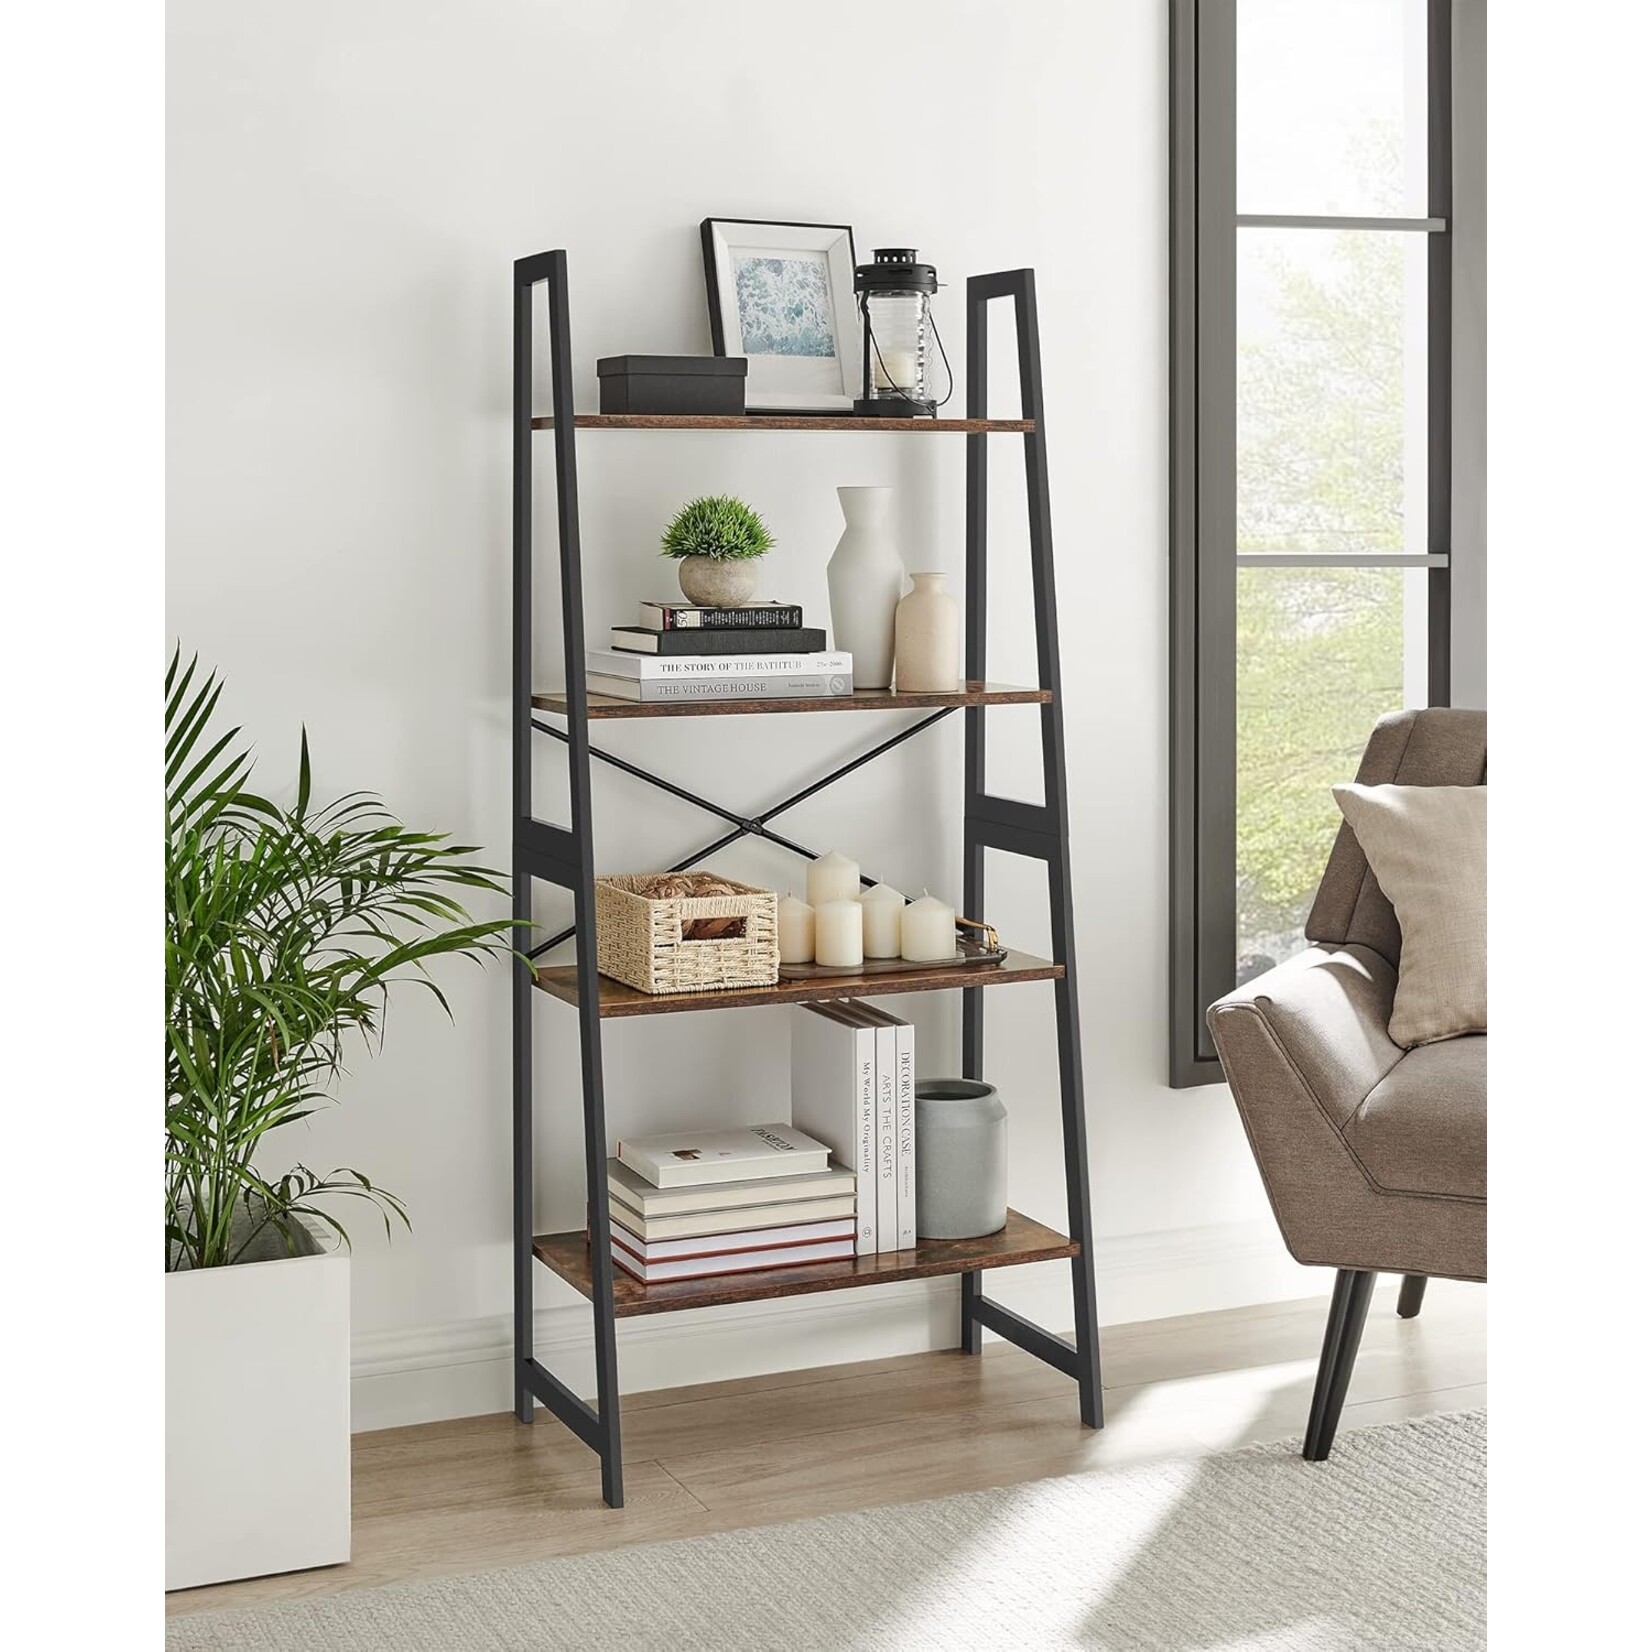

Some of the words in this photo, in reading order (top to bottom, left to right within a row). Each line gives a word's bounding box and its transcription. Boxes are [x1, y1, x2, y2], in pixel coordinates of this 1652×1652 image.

[660, 664, 682, 673] THE
[684, 663, 717, 672] STORY
[718, 662, 732, 671] OF
[734, 662, 755, 671] THE
[756, 661, 802, 671] BATHTUB
[656, 685, 680, 695] THE
[682, 684, 730, 694] VINTAGE
[730, 683, 767, 693] HOUSE
[862, 1062, 871, 1076] My
[863, 1077, 871, 1106] World
[882, 1074, 892, 1103] ARTS
[901, 1052, 911, 1127] DECORATION
[862, 1108, 871, 1122] My
[882, 1107, 892, 1131] THE
[862, 1124, 871, 1173] Originality
[901, 1128, 912, 1157] CASE
[882, 1136, 892, 1179] CRAFTS
